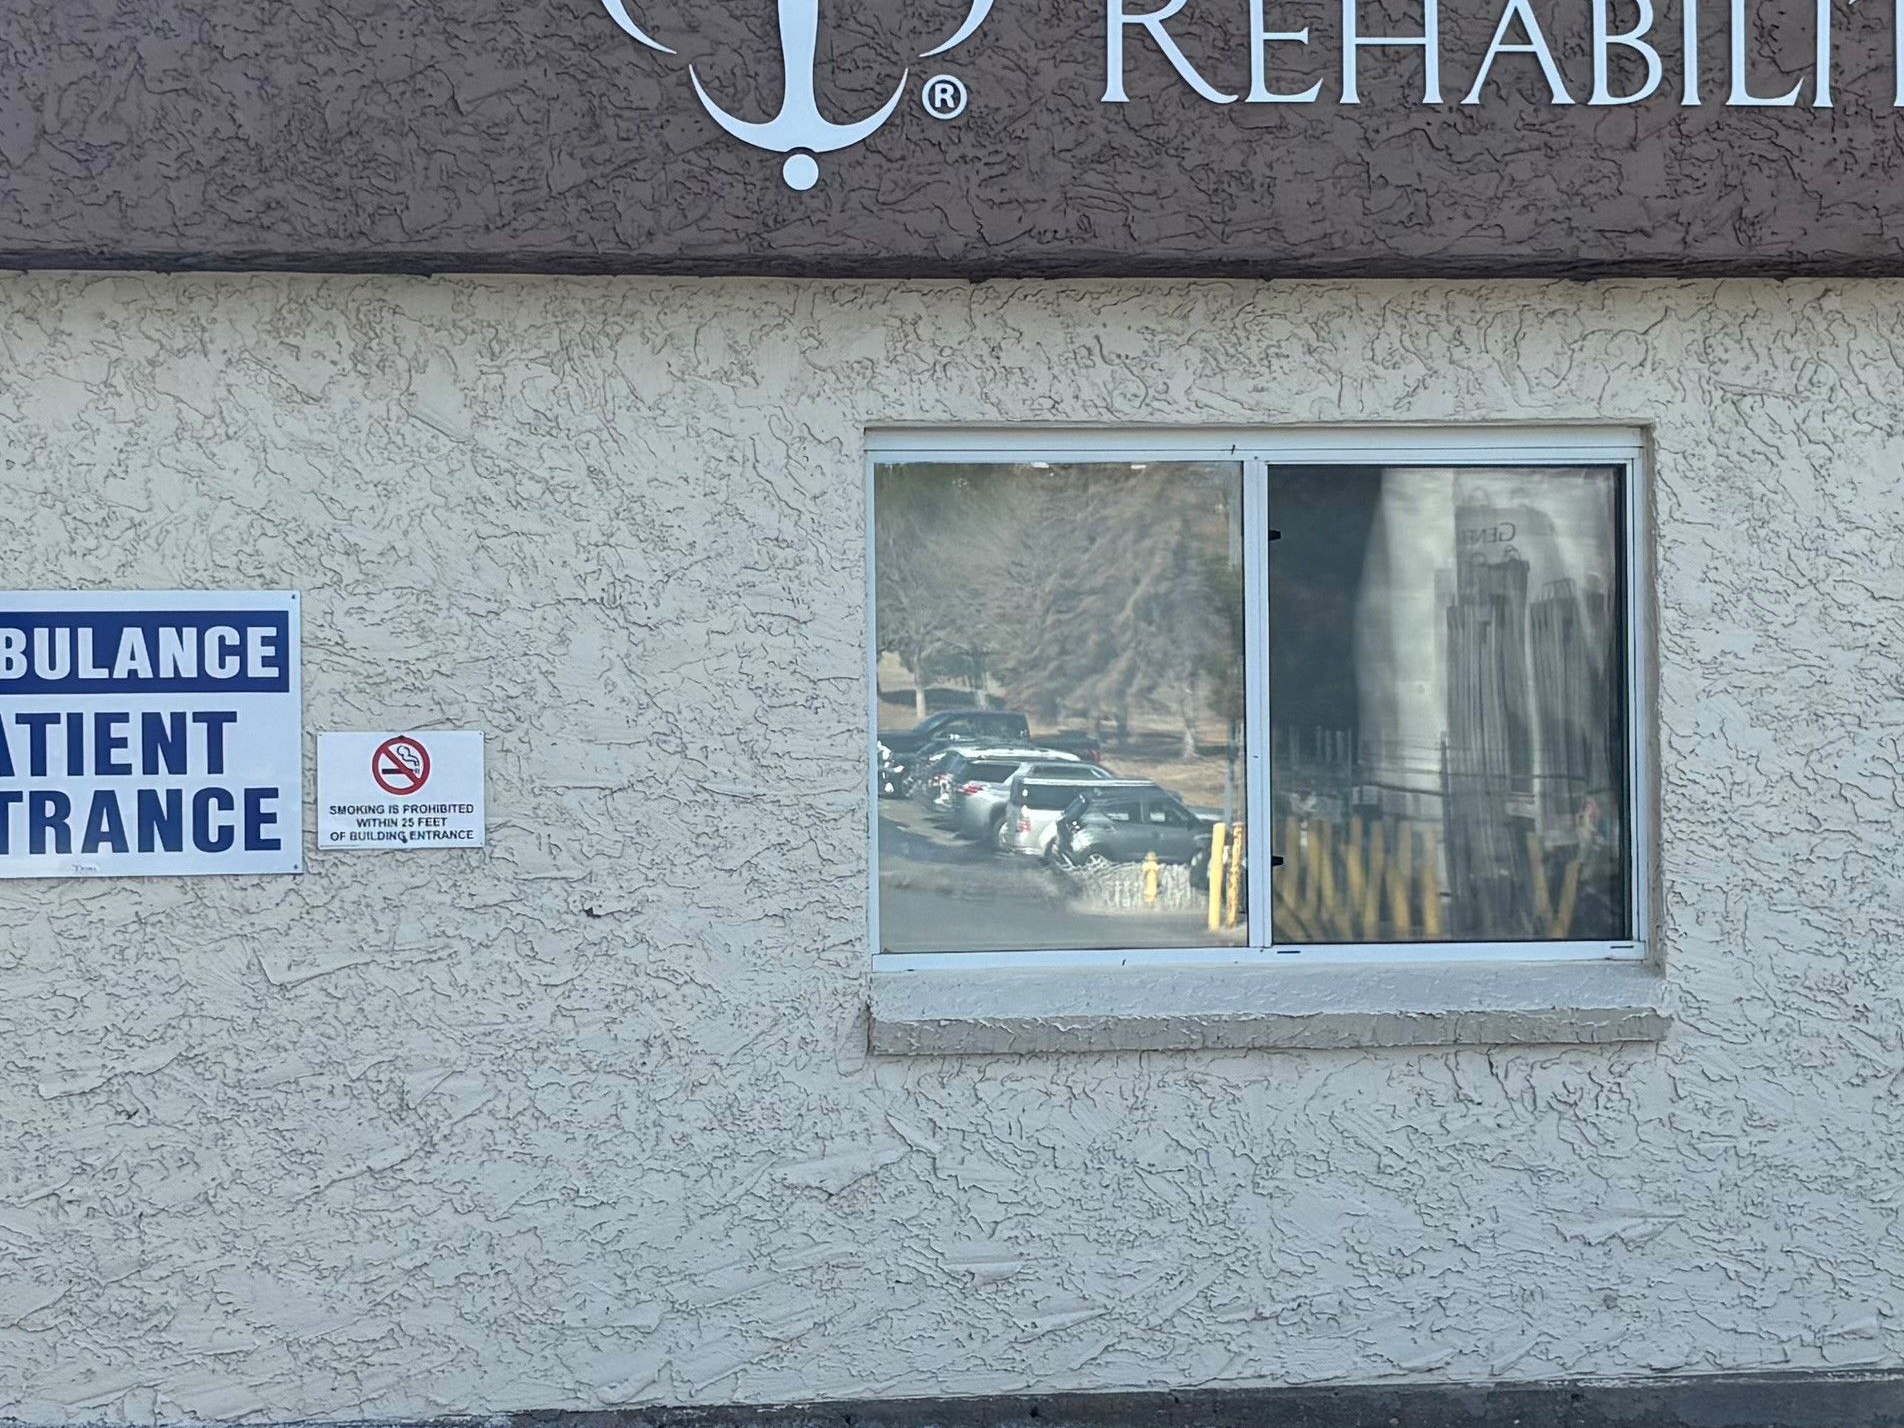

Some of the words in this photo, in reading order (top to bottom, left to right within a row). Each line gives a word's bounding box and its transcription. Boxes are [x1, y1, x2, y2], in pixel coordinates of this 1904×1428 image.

[329, 805, 385, 815] SMOKING
[388, 805, 400, 814] IS
[403, 804, 474, 814] PROHIBITED
[356, 818, 397, 828] WITHIN
[401, 818, 414, 827] 25
[418, 817, 447, 827] FEET
[330, 831, 346, 841] OF
[349, 831, 406, 842] BUILDING
[409, 830, 474, 840] ENTRANCE
